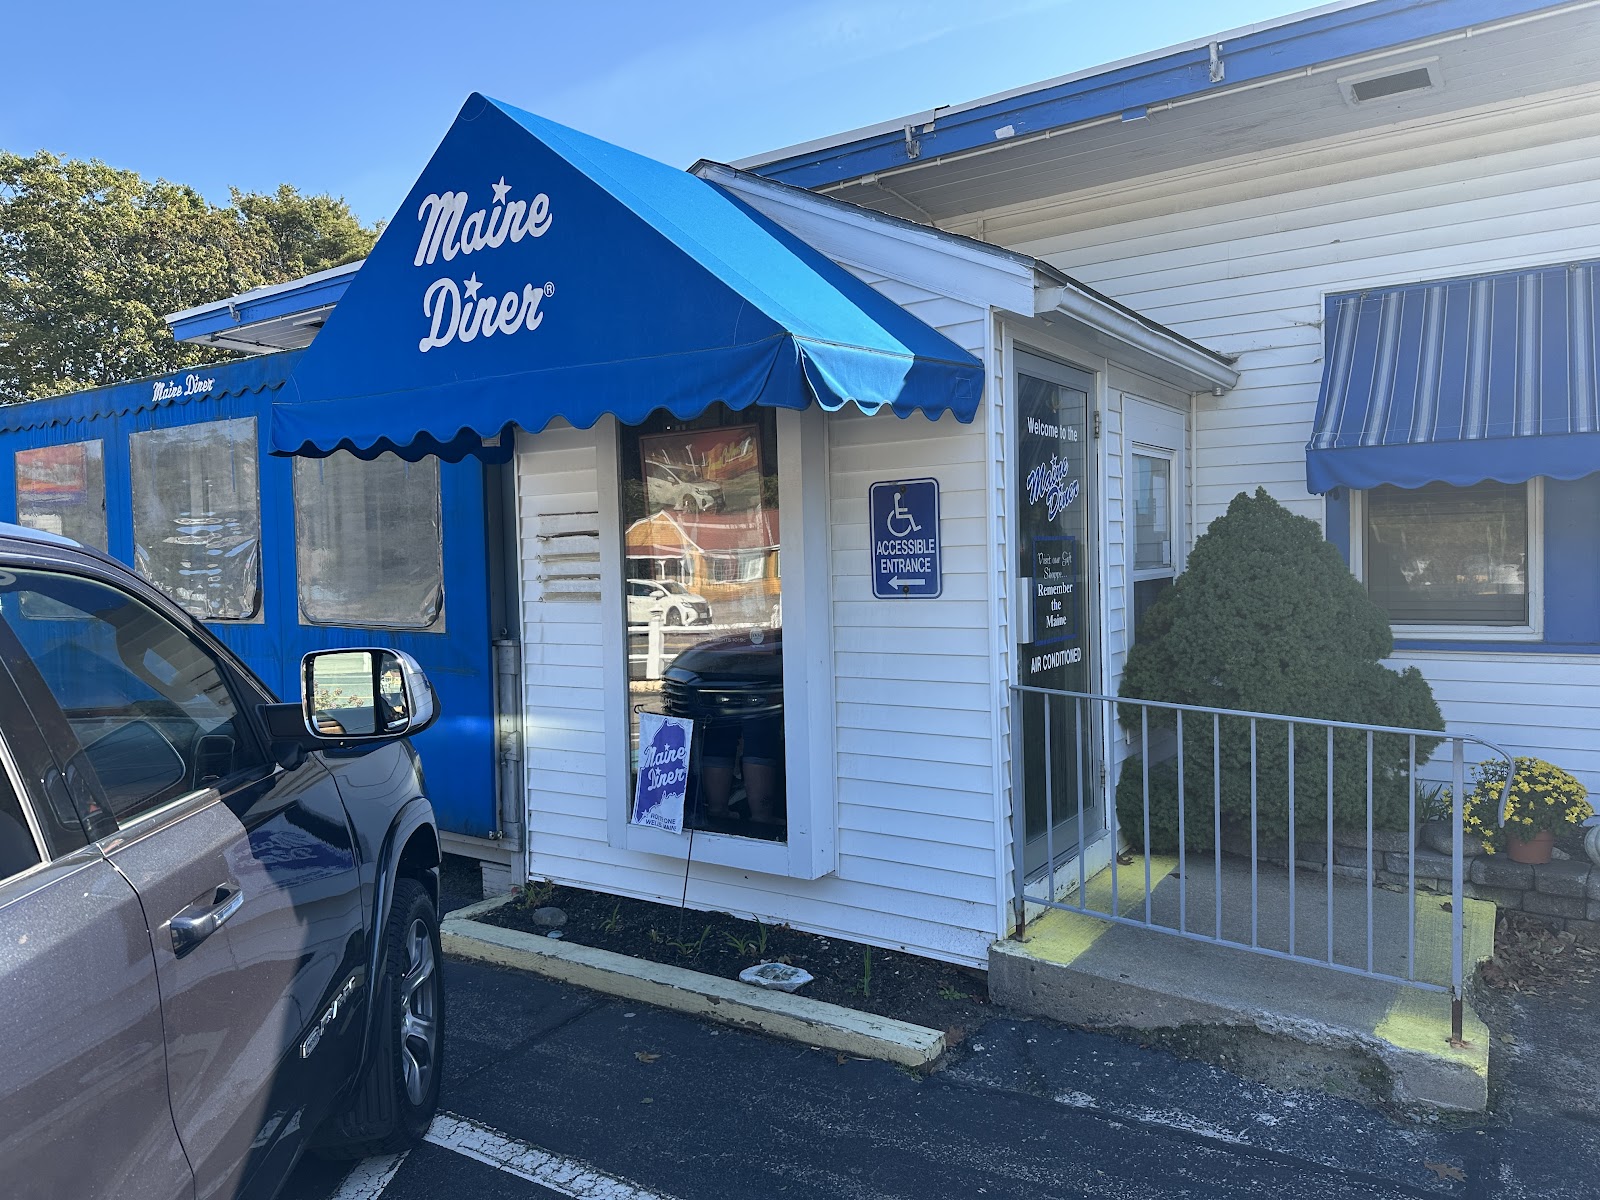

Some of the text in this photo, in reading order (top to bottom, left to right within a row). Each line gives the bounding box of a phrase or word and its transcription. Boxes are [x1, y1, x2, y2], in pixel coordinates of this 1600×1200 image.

[414, 176, 552, 266] Maine
[152, 380, 183, 402] Maine
[1027, 416, 1078, 442] Welcome to the
[1027, 452, 1069, 505] Maine
[1046, 480, 1079, 521] Diner
[877, 539, 935, 555] ACCESSIBLE
[881, 558, 931, 574] ENTRANCE
[1037, 551, 1072, 567] Visit our Gift
[1037, 582, 1073, 597] Remember
[1051, 598, 1062, 611] the
[1046, 614, 1067, 628] Maine
[1030, 647, 1082, 674] AIR CONDITIONED
[644, 743, 686, 768] Maine
[647, 767, 686, 791] Diner
